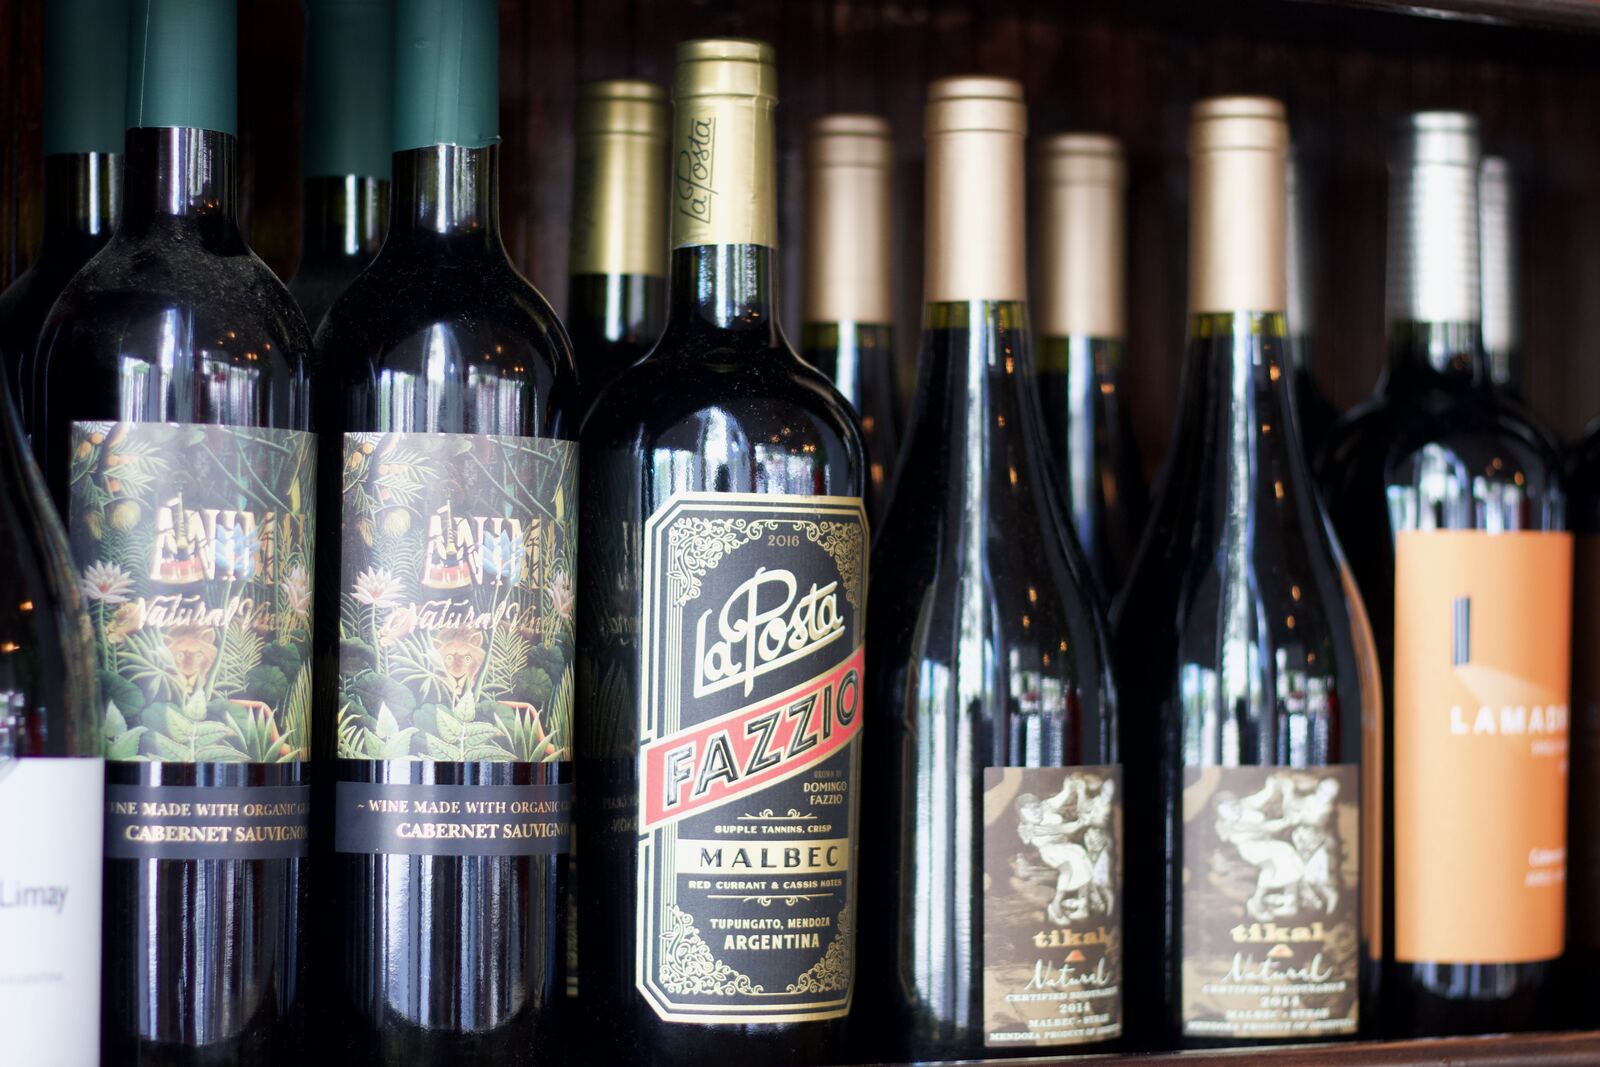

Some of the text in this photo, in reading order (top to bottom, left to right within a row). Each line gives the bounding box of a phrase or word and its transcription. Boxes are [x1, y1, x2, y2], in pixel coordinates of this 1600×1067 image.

[675, 117, 719, 225] La Posta
[767, 534, 800, 548] 2016
[693, 608, 742, 699] La
[718, 566, 846, 699] Posta
[662, 668, 860, 813] FAZZIO
[803, 781, 847, 792] DOMINGO
[368, 799, 409, 814] WINE
[414, 801, 460, 814] MADE
[466, 801, 506, 814] WITH
[511, 800, 560, 814] ORGANIC
[810, 794, 842, 805] FAZZIO
[142, 802, 191, 816] MADE
[196, 802, 240, 816] WITH
[244, 802, 296, 816] ORGANIC
[125, 825, 232, 842] CABERNET
[396, 822, 500, 839] CABERNET
[714, 825, 757, 834] SUPPLE
[808, 824, 832, 833] CRISP
[700, 845, 838, 868] MALBEC
[688, 879, 842, 890] RED CURRANT & CASSIS NOTES
[710, 917, 830, 931] TUPUNGATO, MENDOZA
[724, 933, 820, 950] ARGENTINA
[1032, 926, 1106, 948] tikal
[1230, 922, 1326, 944] tikal
[1023, 957, 1112, 991] Natural
[1220, 952, 1334, 984] Natural
